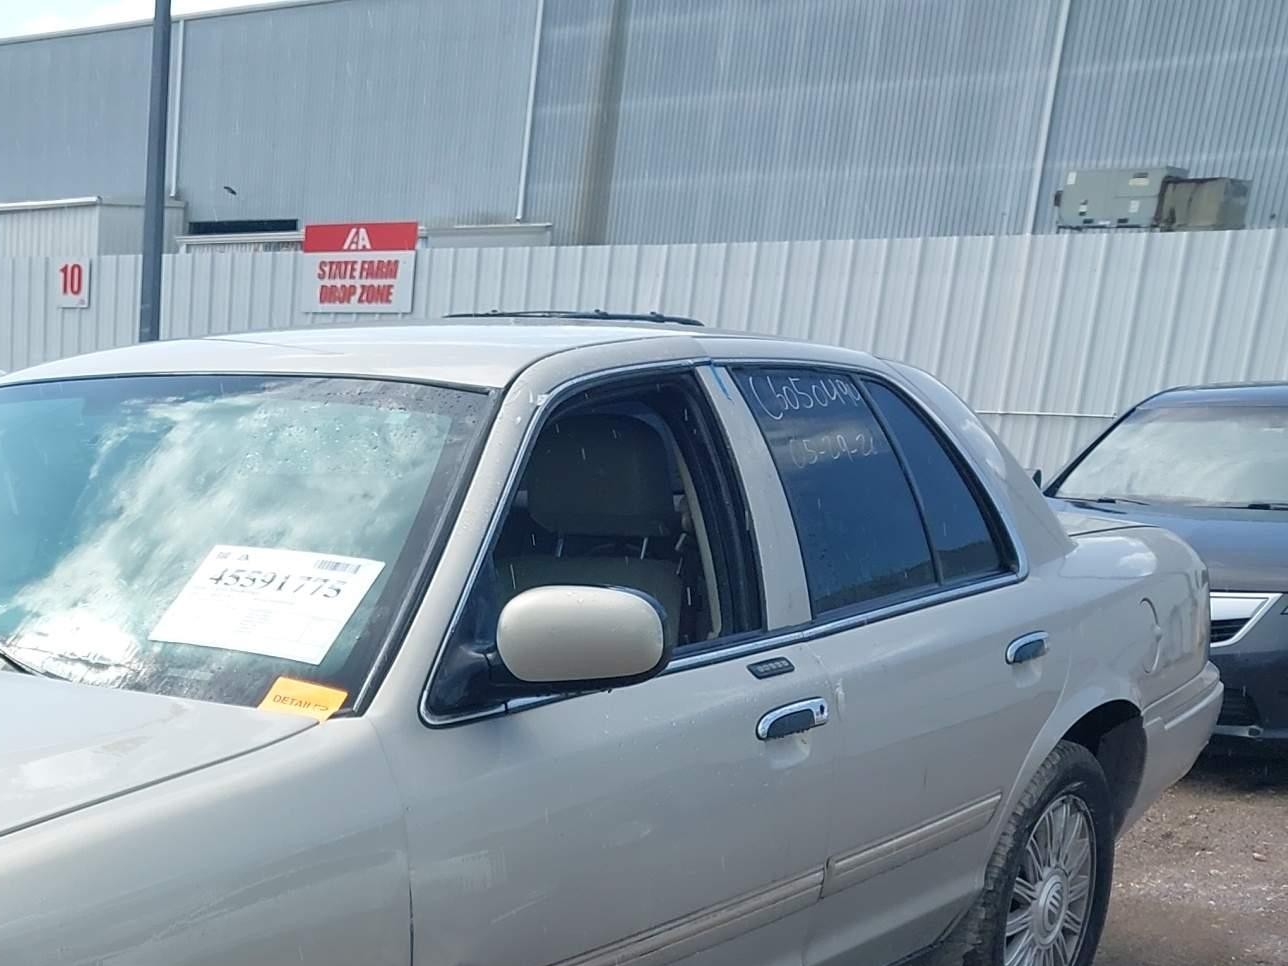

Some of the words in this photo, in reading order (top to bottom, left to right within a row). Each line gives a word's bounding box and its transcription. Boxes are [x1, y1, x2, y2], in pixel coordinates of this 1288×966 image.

[58, 262, 83, 296] 10
[317, 260, 358, 280] STATE
[358, 259, 400, 280] FARM
[319, 284, 357, 304] DROP
[357, 284, 394, 304] ZONE
[209, 568, 349, 599] 45591775
